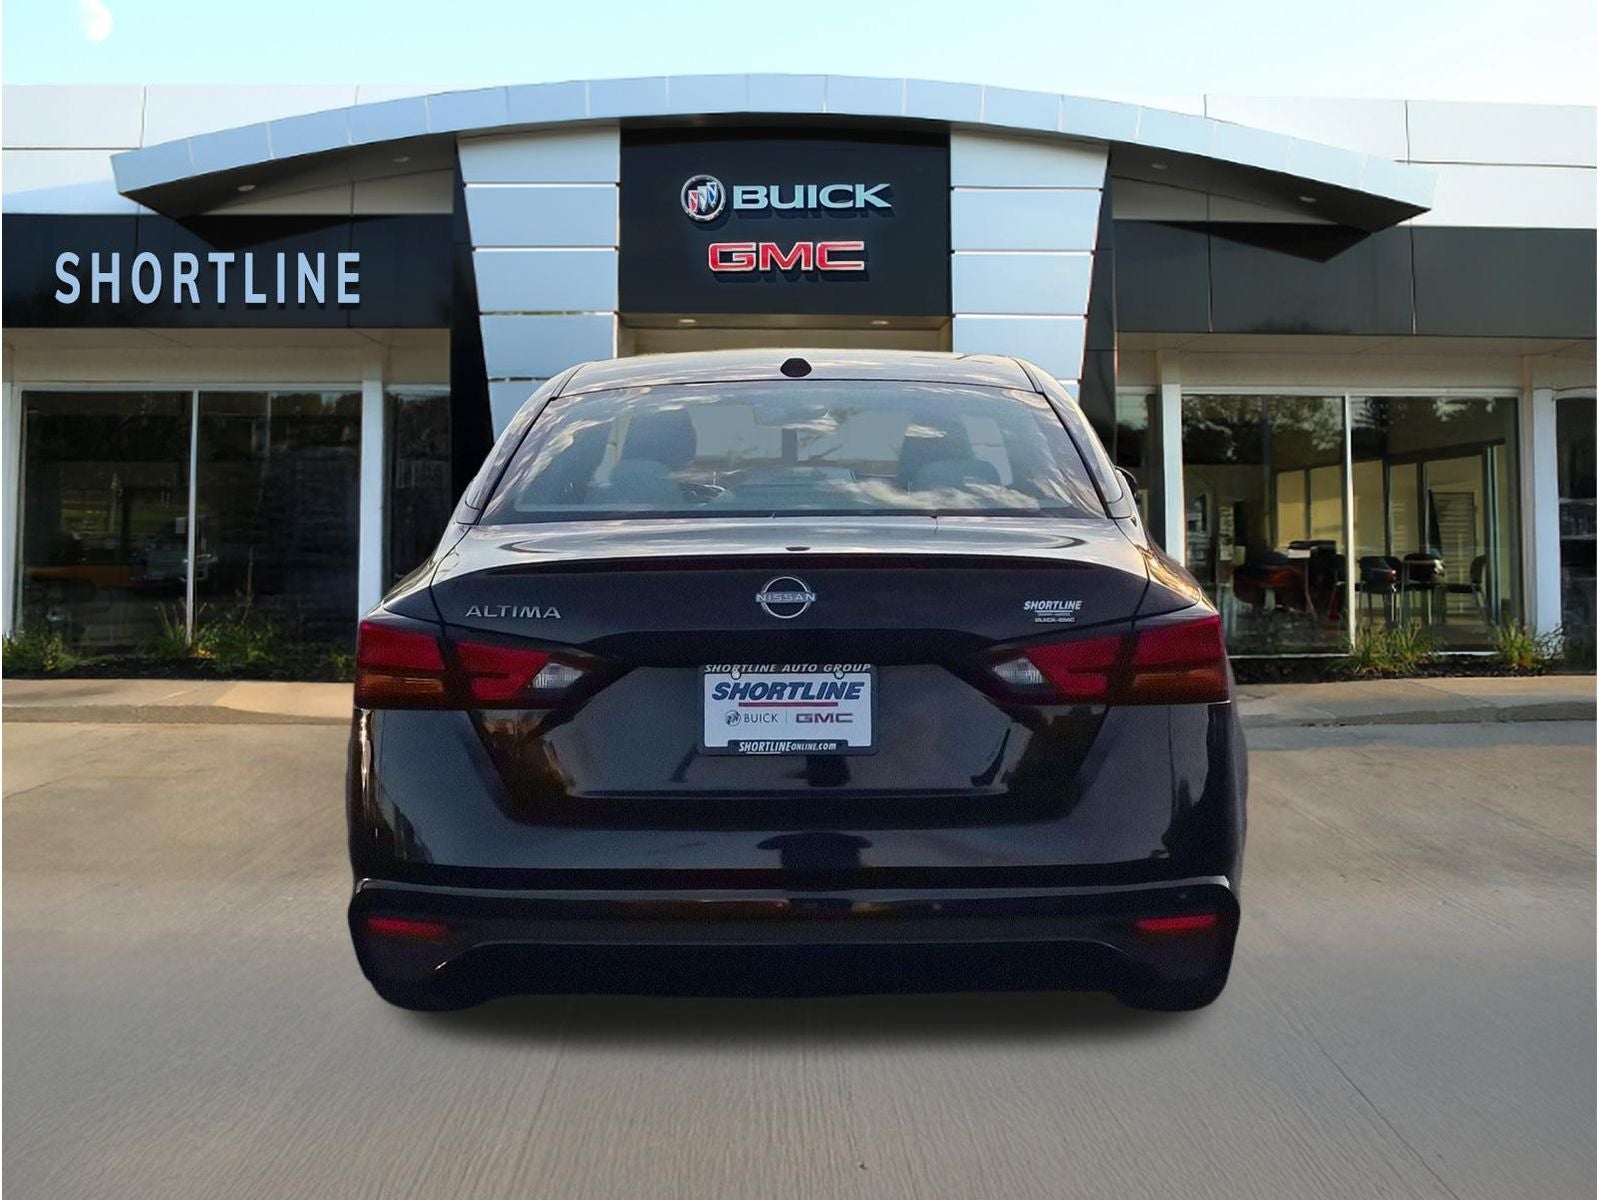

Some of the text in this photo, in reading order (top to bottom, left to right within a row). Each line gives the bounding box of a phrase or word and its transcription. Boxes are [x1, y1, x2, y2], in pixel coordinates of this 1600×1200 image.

[733, 183, 892, 209] BUICK
[708, 241, 865, 271] GMC
[55, 251, 360, 304] SHORTLINE
[756, 592, 816, 603] NISSAN
[465, 605, 561, 619] ALTIMA
[1024, 600, 1083, 610] SHORTLINE
[704, 663, 872, 673] SHORTLINE AUTO GROUP
[712, 681, 864, 700] SHORTLINE
[744, 713, 853, 723] BUICK GMC
